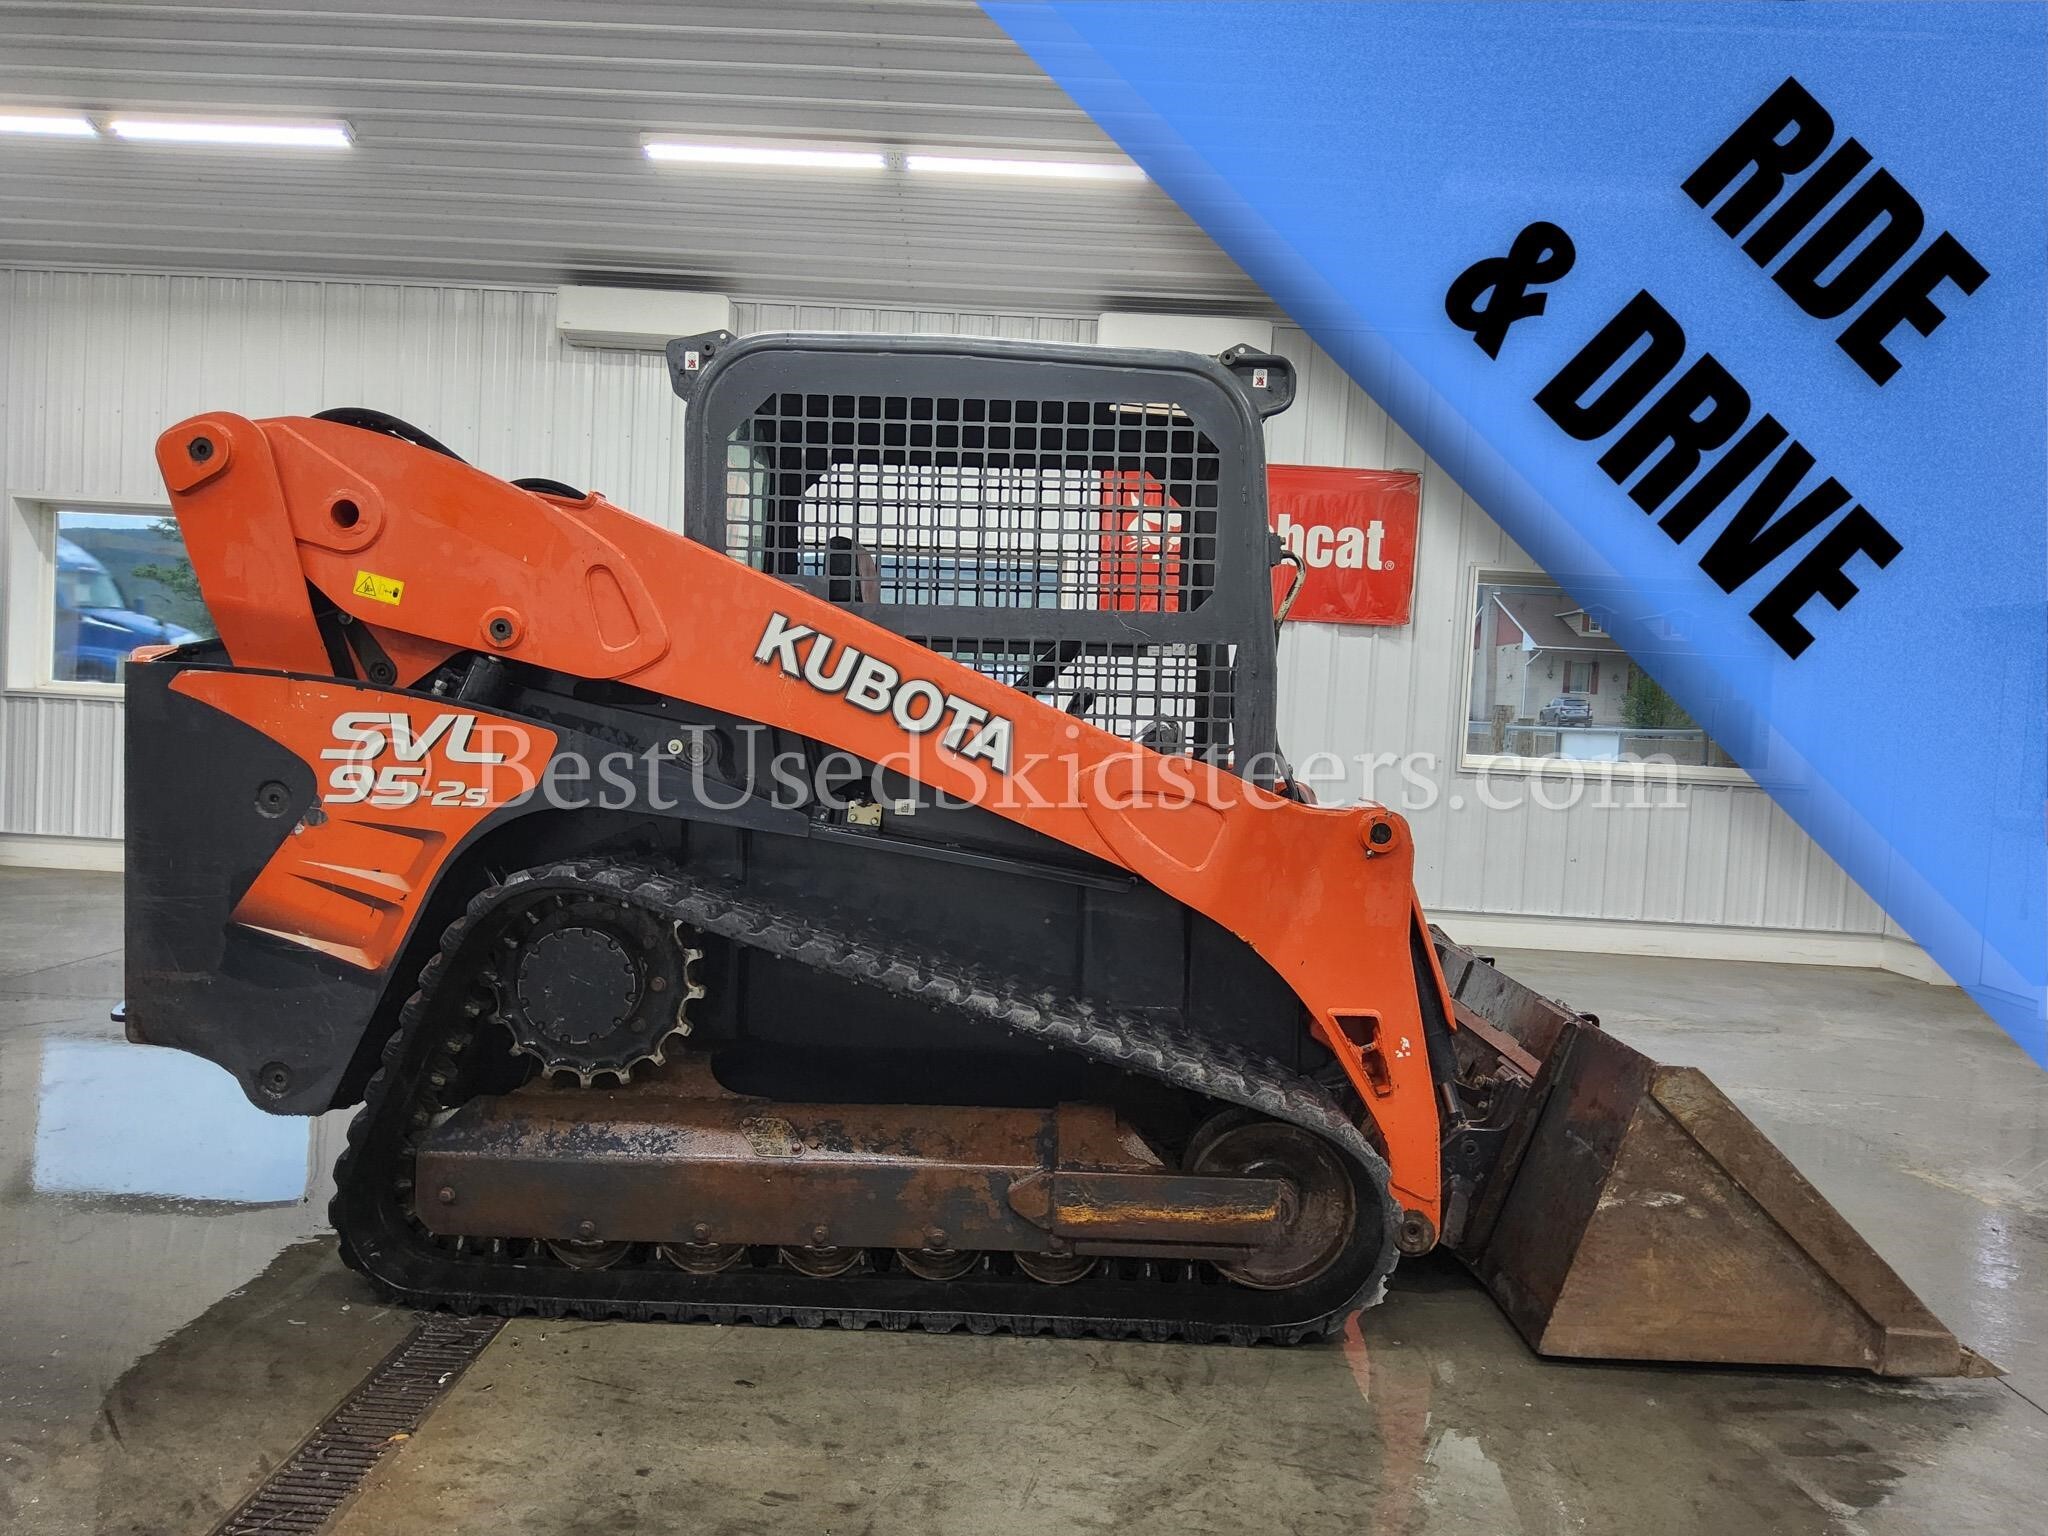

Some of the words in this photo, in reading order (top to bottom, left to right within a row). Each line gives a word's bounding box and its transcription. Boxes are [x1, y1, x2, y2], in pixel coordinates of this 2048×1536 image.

[1269, 513, 1385, 571] bcat
[755, 612, 1013, 774] KUBOTA
[320, 712, 506, 764] SVL
